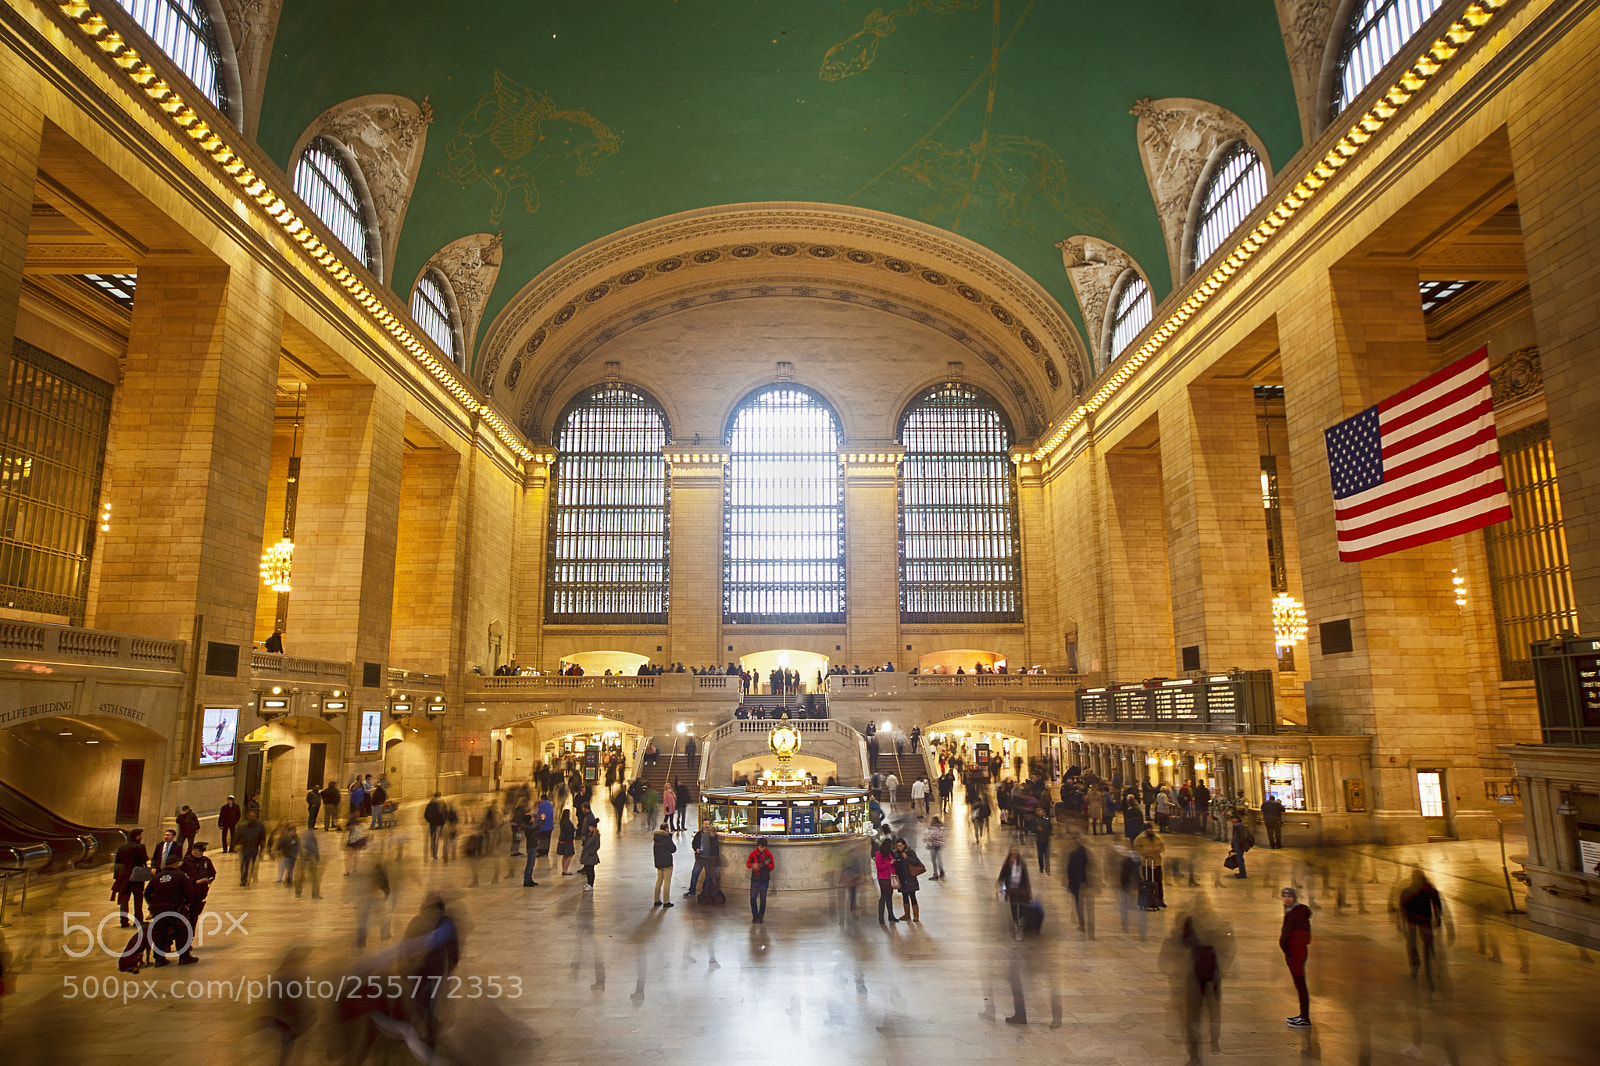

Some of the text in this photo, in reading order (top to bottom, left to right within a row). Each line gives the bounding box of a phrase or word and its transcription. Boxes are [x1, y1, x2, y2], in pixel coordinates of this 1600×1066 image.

[29, 701, 72, 717] BUILDING
[98, 703, 146, 721] 45TH STREET
[578, 708, 613, 718] LEXINGTON
[943, 707, 978, 719] LEXINGTON
[515, 711, 538, 720] TRACKS
